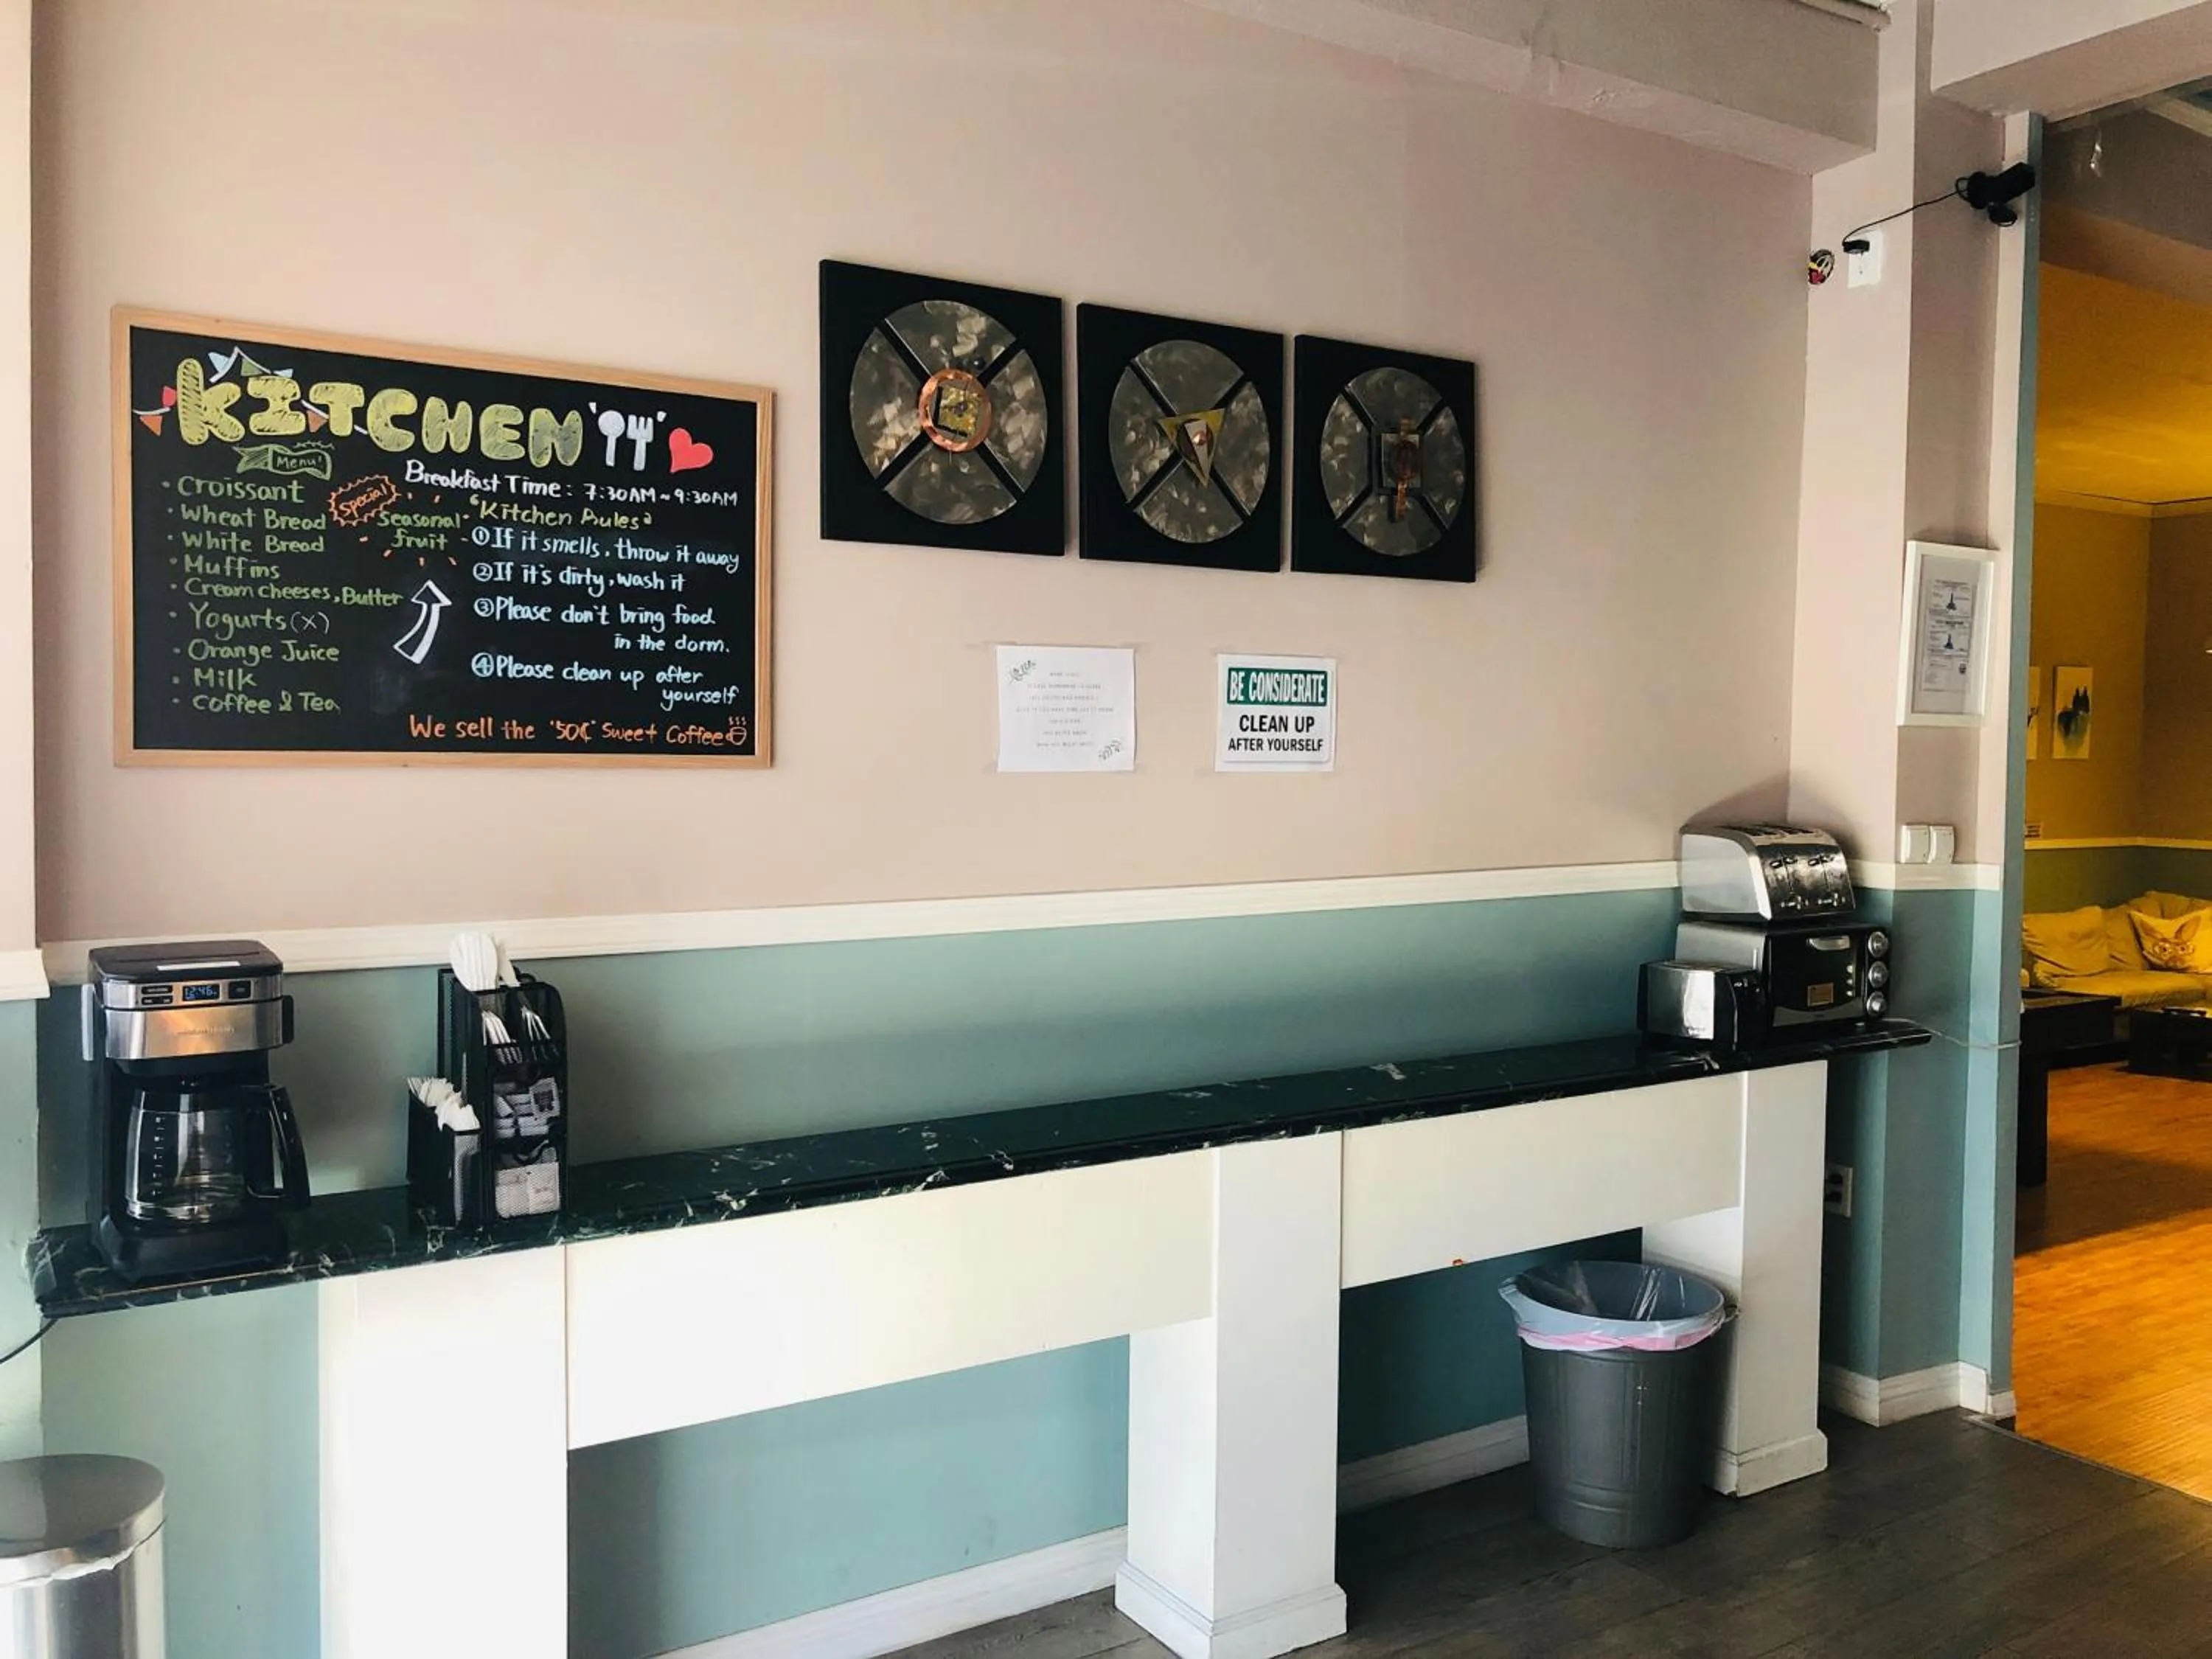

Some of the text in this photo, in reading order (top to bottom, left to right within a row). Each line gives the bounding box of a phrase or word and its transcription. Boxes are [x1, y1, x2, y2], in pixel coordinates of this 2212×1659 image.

[177, 358, 582, 467] KITCHEN
[406, 459, 501, 493] Breakfast
[178, 476, 305, 504] Croissant
[181, 504, 327, 531] Wheat Bread
[181, 532, 325, 553] White Bread
[391, 529, 448, 551] fruit
[522, 531, 538, 551] it
[613, 538, 669, 561] throw
[676, 545, 691, 563] it
[695, 551, 740, 574] away
[184, 554, 280, 579] Muffins
[184, 577, 254, 597] Cream
[617, 571, 664, 590] wash
[670, 573, 686, 591] it
[560, 603, 611, 625] don't
[619, 603, 665, 633] bring
[674, 604, 716, 625] food
[187, 639, 341, 667] Orange Juice
[614, 633, 631, 650] in
[637, 634, 665, 653] the
[193, 667, 257, 692] Milk
[562, 661, 611, 682] clean
[620, 671, 644, 691] up
[655, 665, 704, 684] after
[1230, 671, 1325, 703] BE CONSIDERATE
[298, 691, 341, 717] Tea
[661, 685, 740, 712] yourself
[409, 714, 446, 738] We
[455, 717, 494, 739] sell
[501, 719, 536, 740] the
[601, 721, 658, 744] Sweet
[666, 725, 730, 746] Coffee
[1239, 714, 1315, 734] CLEAN UP
[1228, 737, 1324, 752] AFTER YOURSELF
